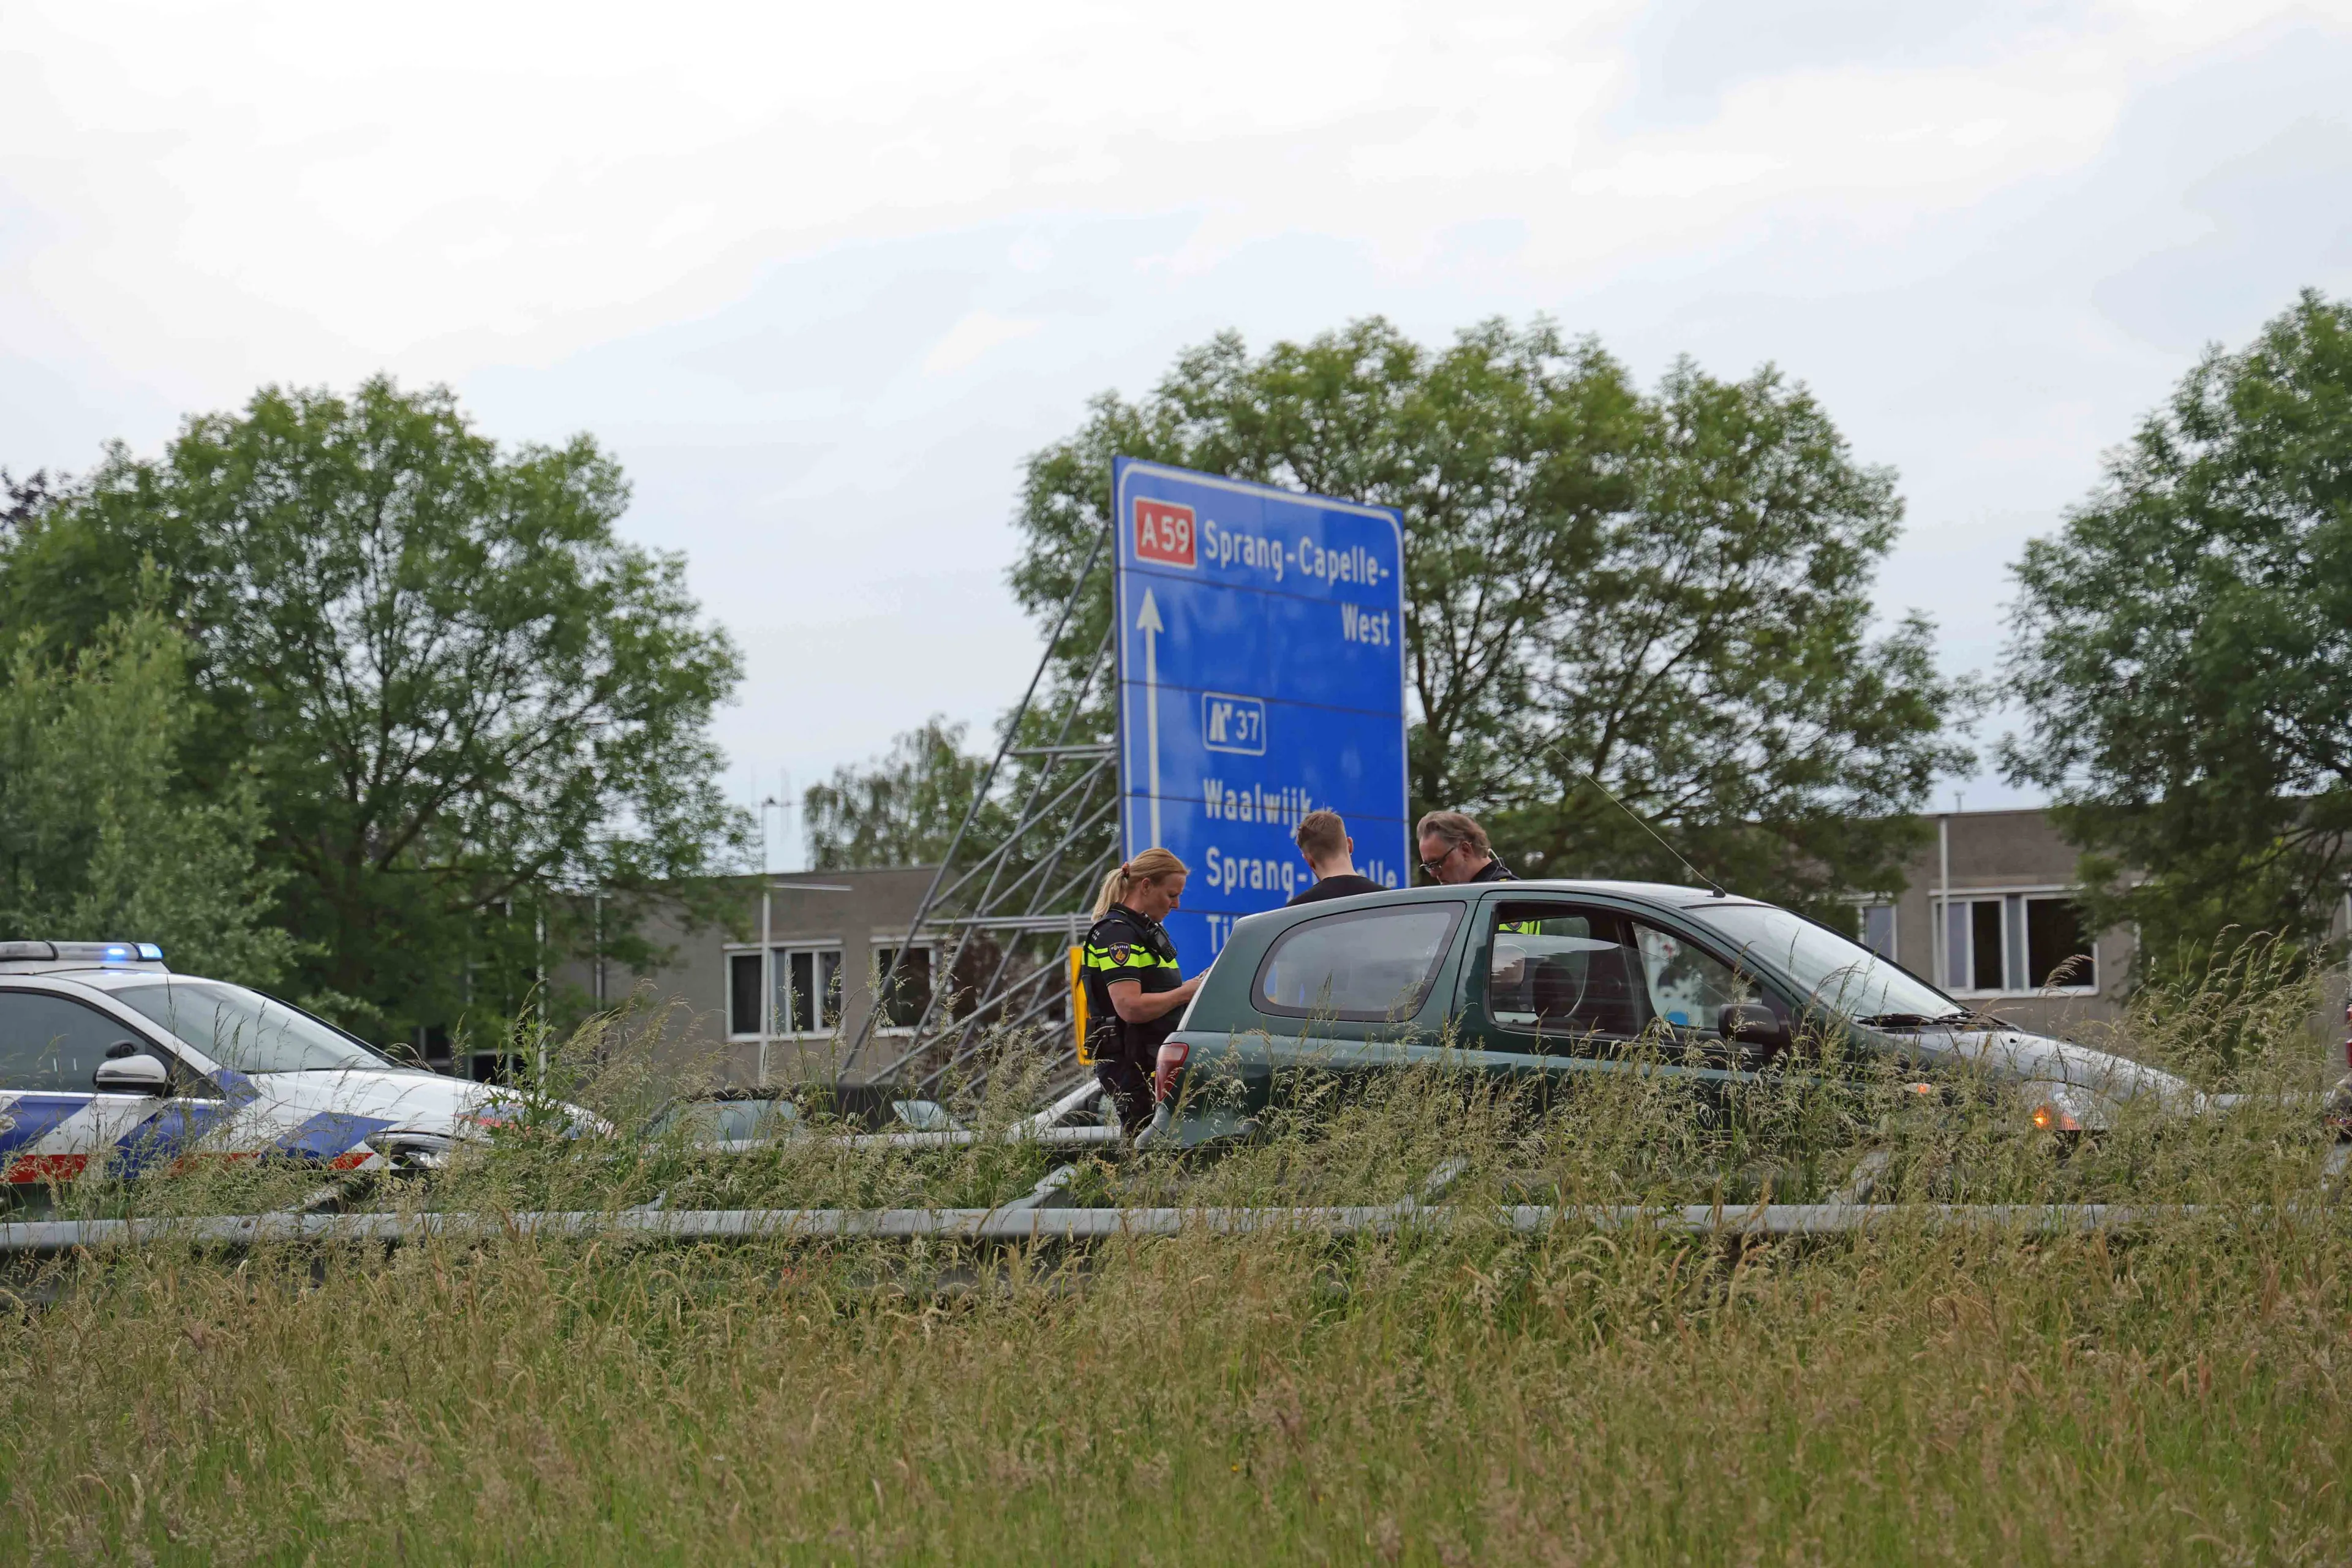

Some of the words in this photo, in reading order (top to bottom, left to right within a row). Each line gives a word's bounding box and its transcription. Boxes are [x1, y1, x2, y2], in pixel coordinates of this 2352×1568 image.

[1205, 519, 1389, 585] Sprang-Capelle-
[1342, 603, 1391, 647] West
[1235, 711, 1261, 741] 37
[1204, 778, 1313, 839] Waalwijk
[1207, 846, 1397, 902] Sprang-lle
